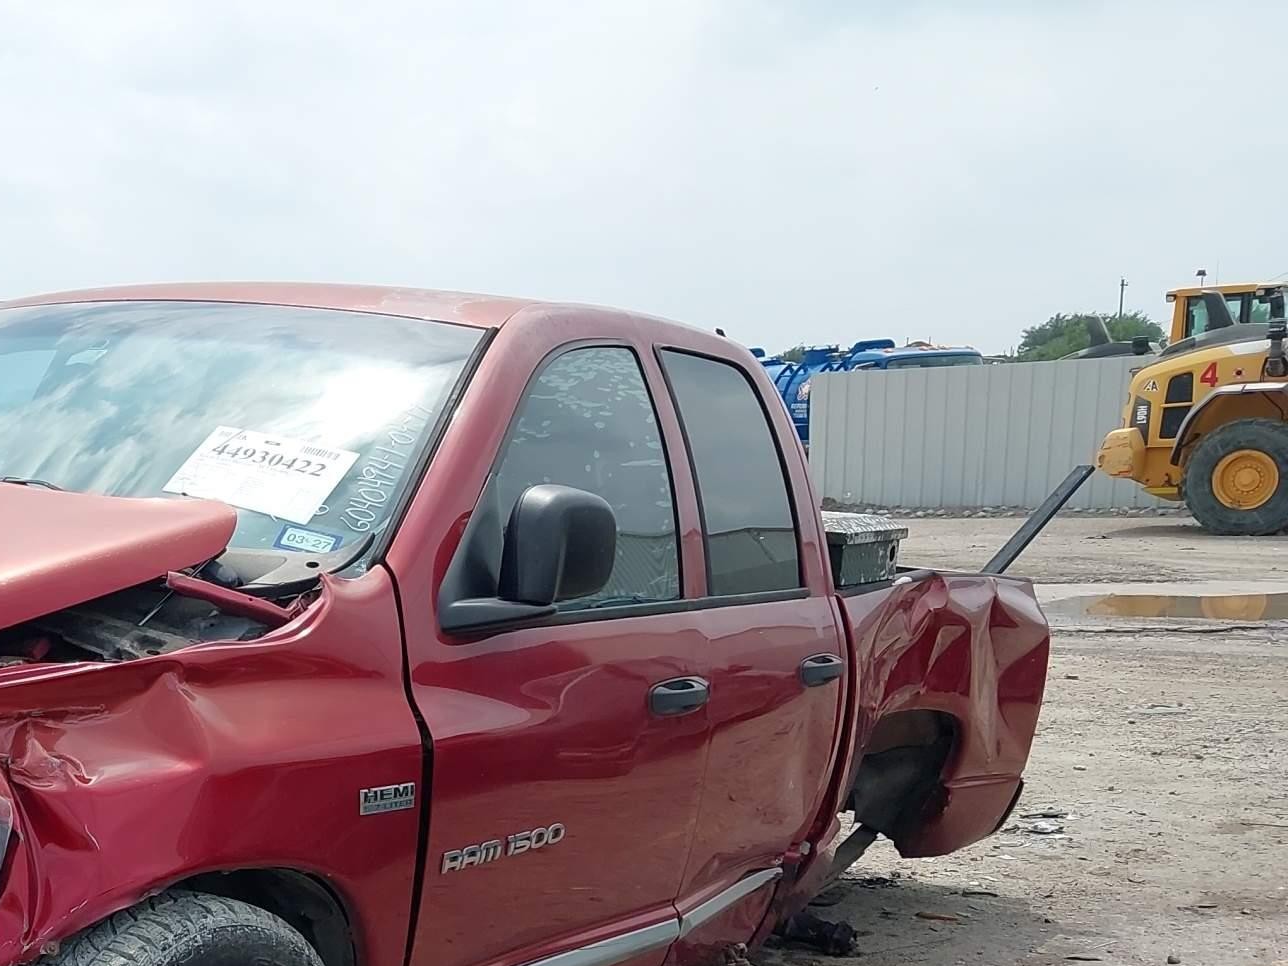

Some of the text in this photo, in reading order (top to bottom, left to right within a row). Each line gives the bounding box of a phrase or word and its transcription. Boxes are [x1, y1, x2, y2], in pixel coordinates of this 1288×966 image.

[1200, 361, 1219, 387] 4
[212, 443, 327, 477] 44930422
[287, 533, 332, 550] 03 27
[363, 784, 415, 804] HEMI
[442, 822, 566, 874] RAM 1500
